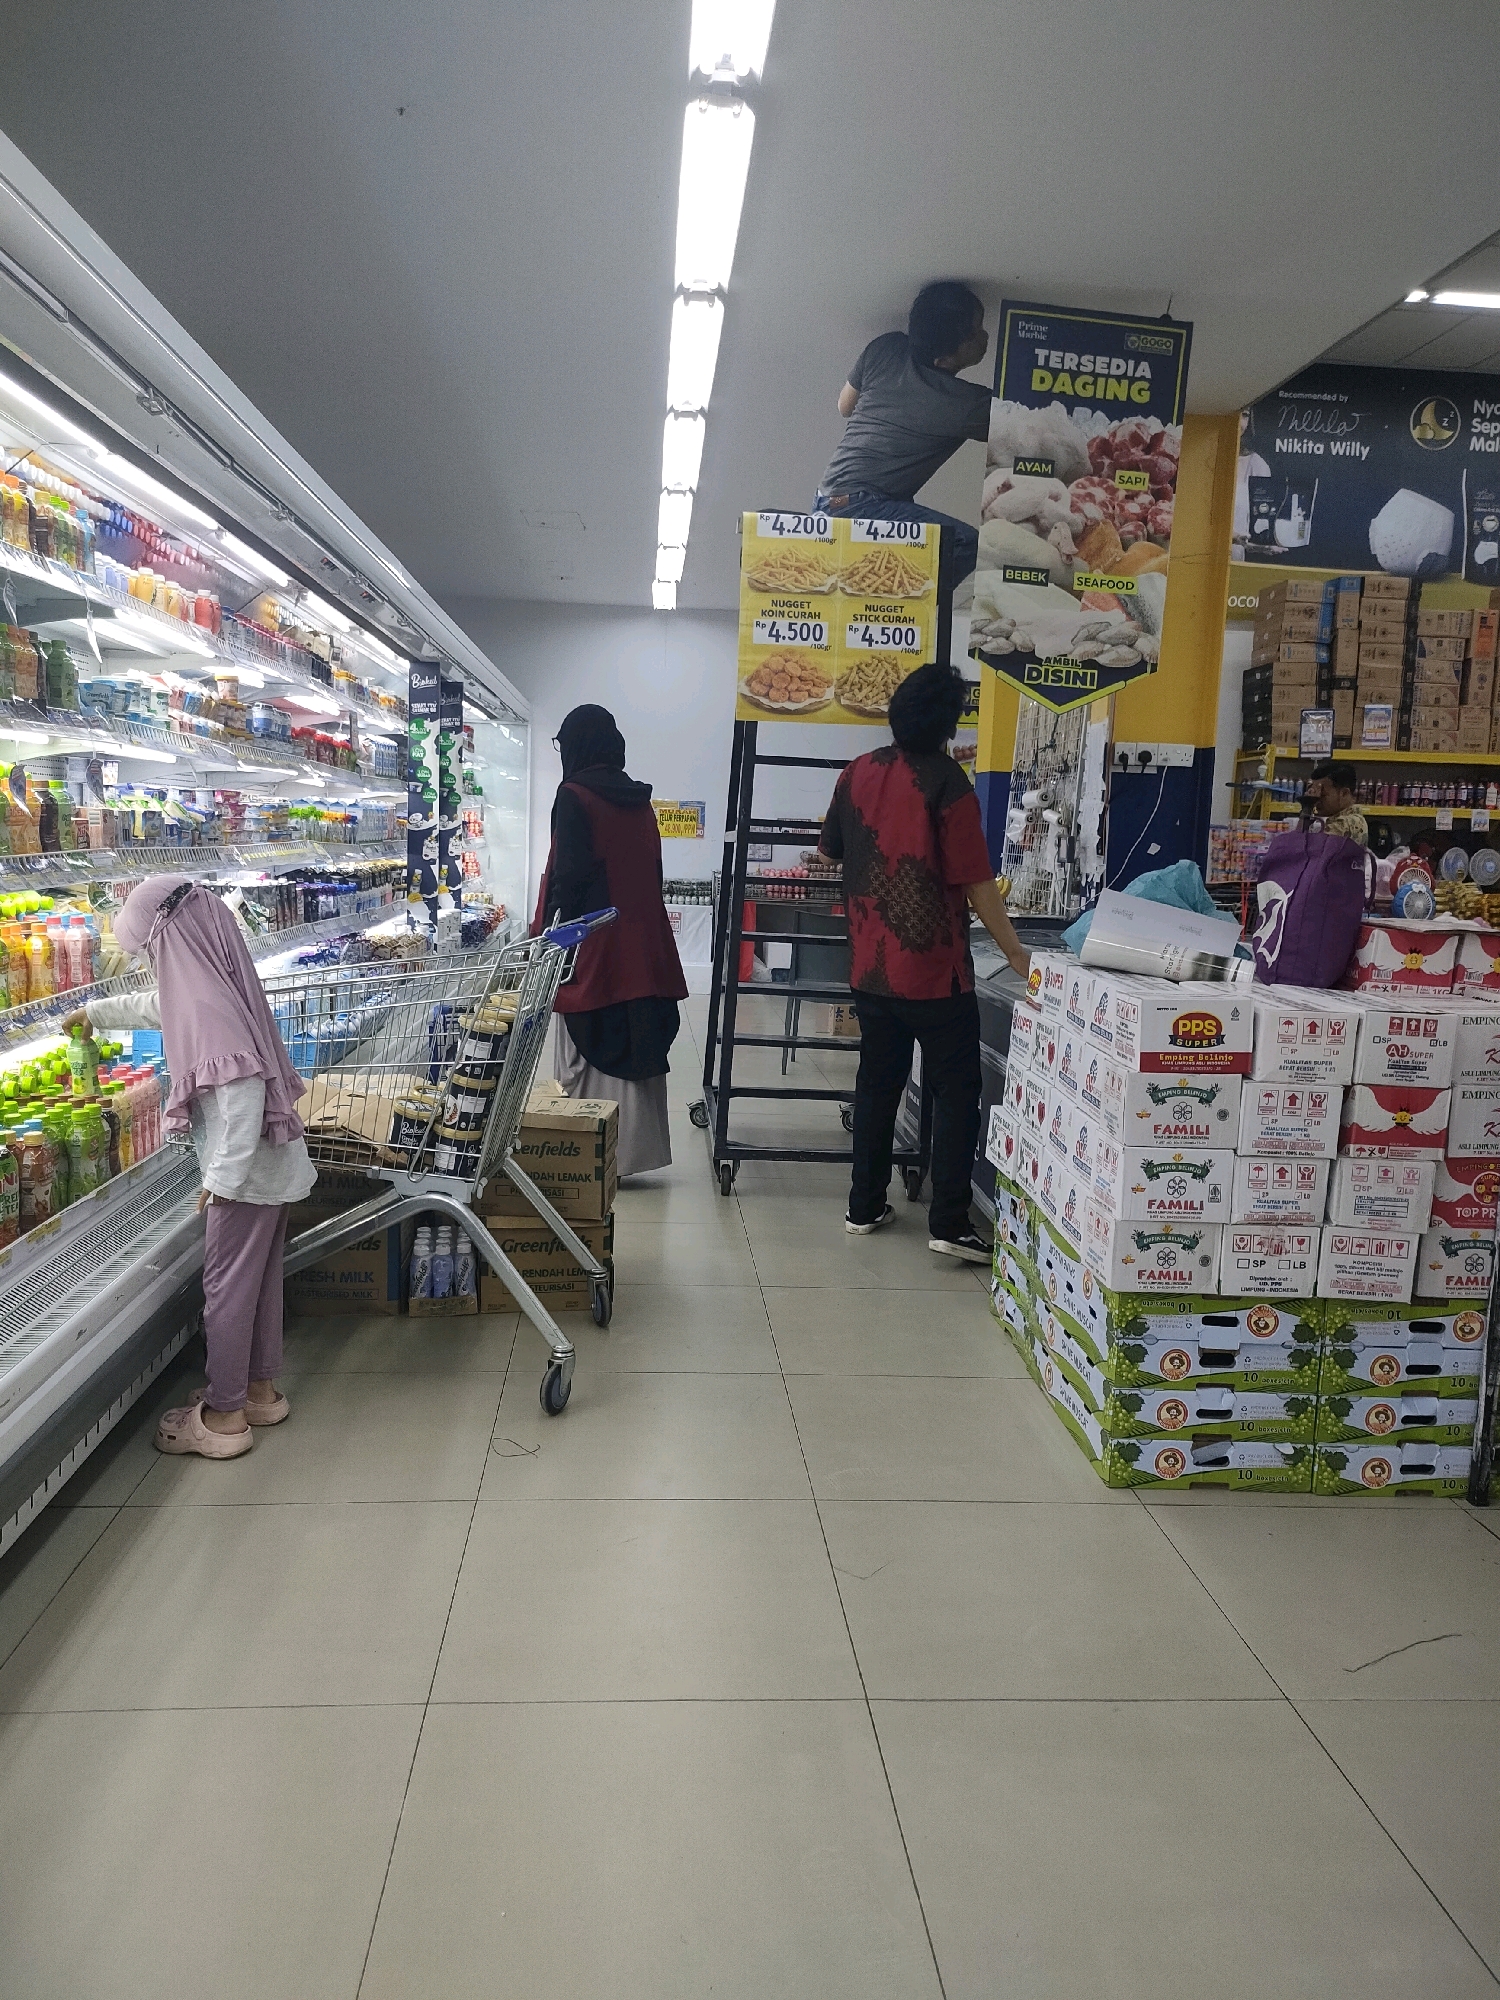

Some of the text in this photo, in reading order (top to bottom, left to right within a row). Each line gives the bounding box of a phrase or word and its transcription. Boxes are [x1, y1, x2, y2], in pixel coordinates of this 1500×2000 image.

[1018, 320, 1048, 331] Prime
[1018, 331, 1048, 341] Marble
[1141, 337, 1171, 348] GOGO
[1034, 348, 1152, 379] TERSEDIA
[1031, 369, 1151, 404] DAGING
[1279, 390, 1349, 403] Recommended by
[1275, 438, 1370, 461] Nikita Willy
[1016, 461, 1052, 475] AYAM
[1118, 474, 1146, 486] SAPI
[759, 514, 837, 545] Rp 4.200 /100gr
[866, 521, 921, 541] 4.200
[905, 541, 929, 550] /100gr
[1005, 569, 1046, 583] BEBEK
[1076, 576, 1135, 591] SEAFOOD
[771, 599, 812, 610] NUGGET
[864, 603, 905, 614] NUGGET
[761, 609, 821, 620] KOIN CURAH
[852, 613, 915, 625] STICK CURAH
[755, 621, 832, 652] Rp 4.500 /100gr
[848, 625, 923, 656] Rp 4.500 /100gr
[1042, 654, 1081, 668] AMBIL
[1025, 667, 1098, 689] DISINI
[1178, 1020, 1217, 1036] PPS
[1176, 1038, 1218, 1047] SUPER
[1159, 1053, 1234, 1062] Emping Belinjo
[1387, 1045, 1435, 1059] AH SUPER
[1153, 1124, 1211, 1136] FAMILI
[1456, 1163, 1488, 1173] EMPING
[526, 1171, 592, 1183] NDAH LEMAK
[1147, 1199, 1205, 1211] FAMILI
[1456, 1207, 1479, 1218] TOP
[501, 1235, 592, 1255] Greenfies
[1252, 1259, 1307, 1269] SP LB
[293, 1270, 375, 1284] FRESH MILK
[522, 1268, 588, 1279] RENDAH LEM
[1137, 1269, 1193, 1281] FAMILI
[352, 1290, 373, 1298] MILK
[1178, 1302, 1194, 1314] 10
[1387, 1310, 1402, 1320] 10
[1073, 1356, 1091, 1382] MUSCAT
[1243, 1372, 1259, 1383] 10
[1450, 1377, 1466, 1388] 10
[1071, 1402, 1089, 1429] MUSCAT
[1239, 1421, 1255, 1432] 10
[1445, 1426, 1461, 1436] 10
[1237, 1469, 1253, 1480] 10
[1441, 1479, 1456, 1490] 10
